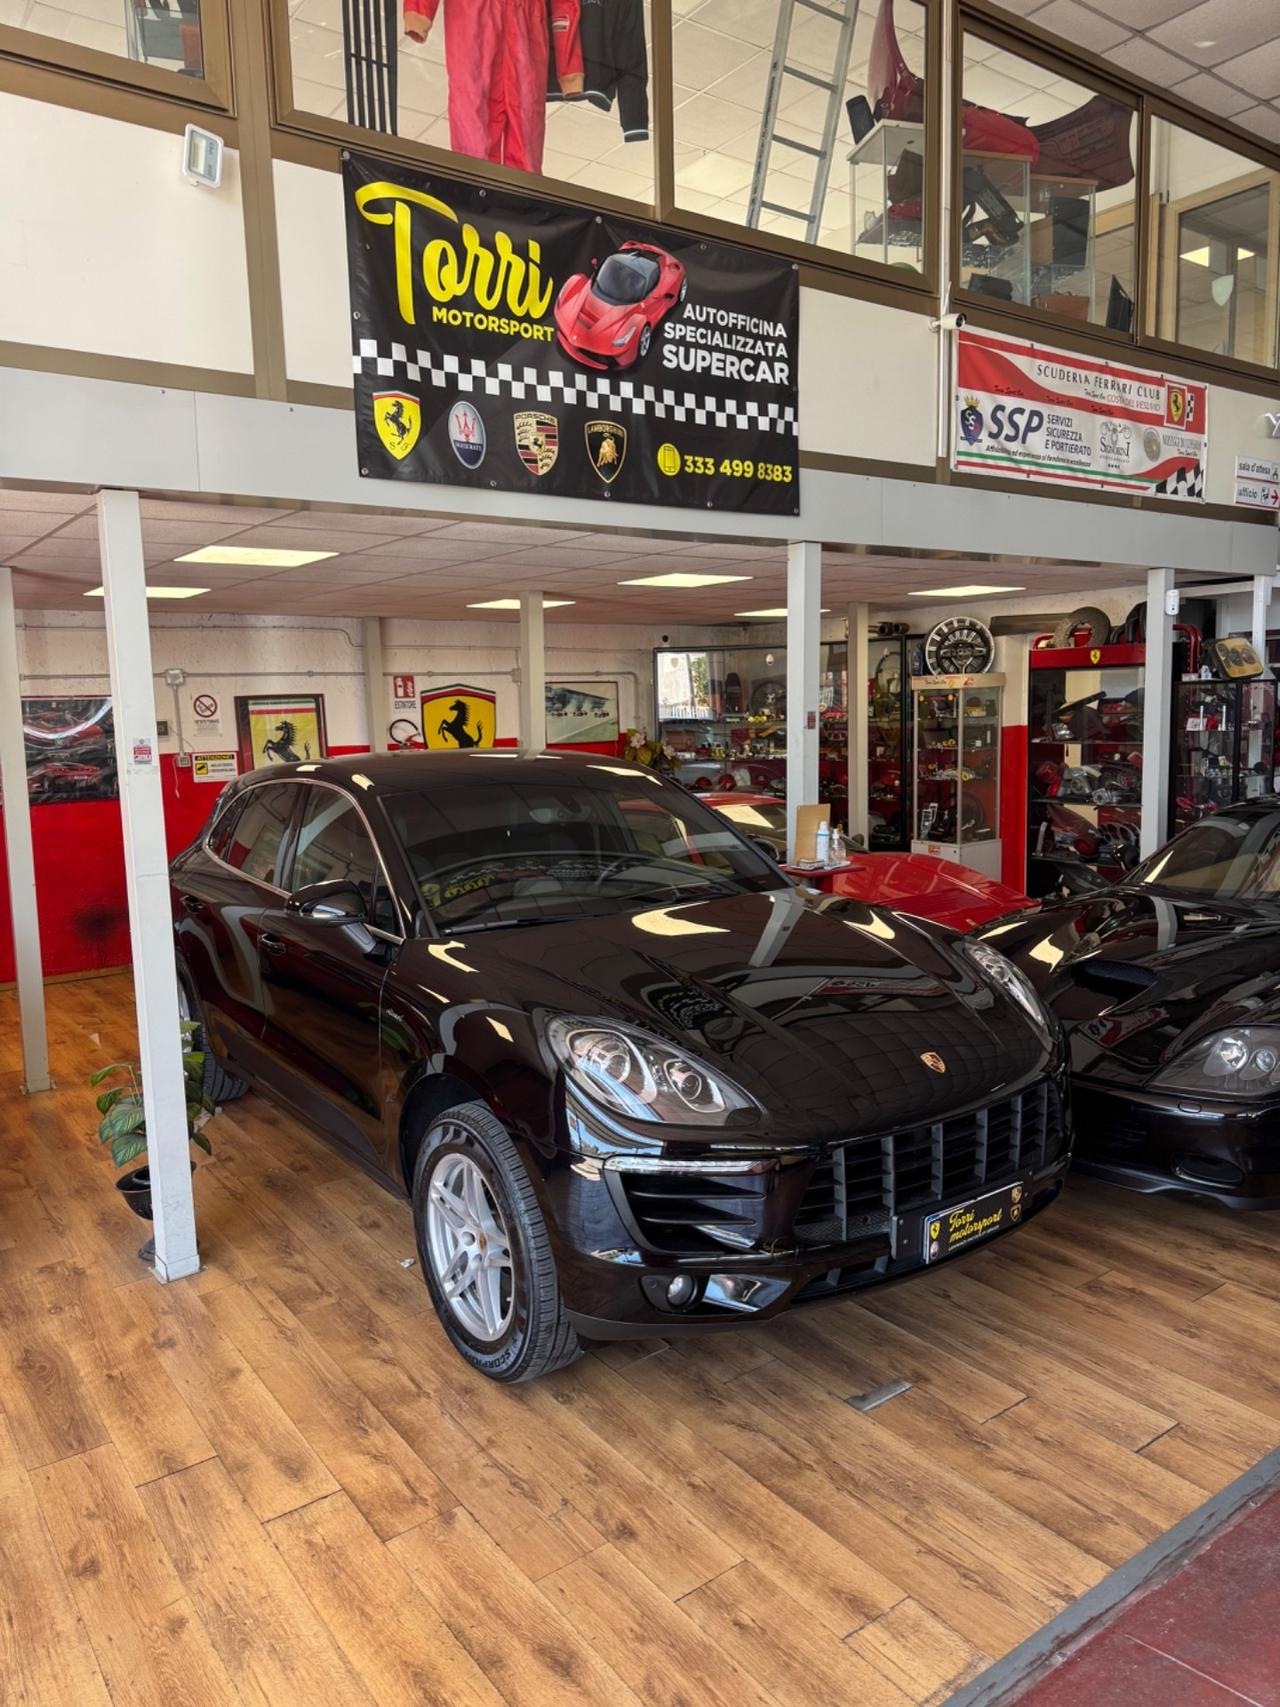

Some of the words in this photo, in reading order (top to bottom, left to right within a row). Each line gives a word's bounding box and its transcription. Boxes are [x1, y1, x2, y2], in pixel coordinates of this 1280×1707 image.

[355, 181, 554, 325] Torri
[432, 306, 554, 342] MOTORSPORT
[683, 303, 788, 338] AUTOFFICINA
[663, 321, 788, 358] SPECIALIZZATA
[662, 344, 790, 385] SUPERCAR
[1037, 364, 1090, 385] SCUDERIA
[1094, 376, 1132, 395] FERRARI
[1136, 385, 1160, 400] CLUB
[515, 412, 556, 425] PORSCHE
[988, 403, 1044, 444] SSP
[1047, 414, 1072, 428] SERVIZI
[1045, 439, 1050, 449] E
[1051, 440, 1091, 456] PORTIERATO
[1046, 427, 1083, 442] SICUREZZA
[683, 455, 715, 476] 333
[719, 459, 755, 479] 499
[757, 462, 793, 483] 8383
[1239, 462, 1250, 472] sala
[1238, 486, 1258, 499] ufficio
[949, 1208, 975, 1232] Torri
[949, 1207, 1003, 1243] motorsport
